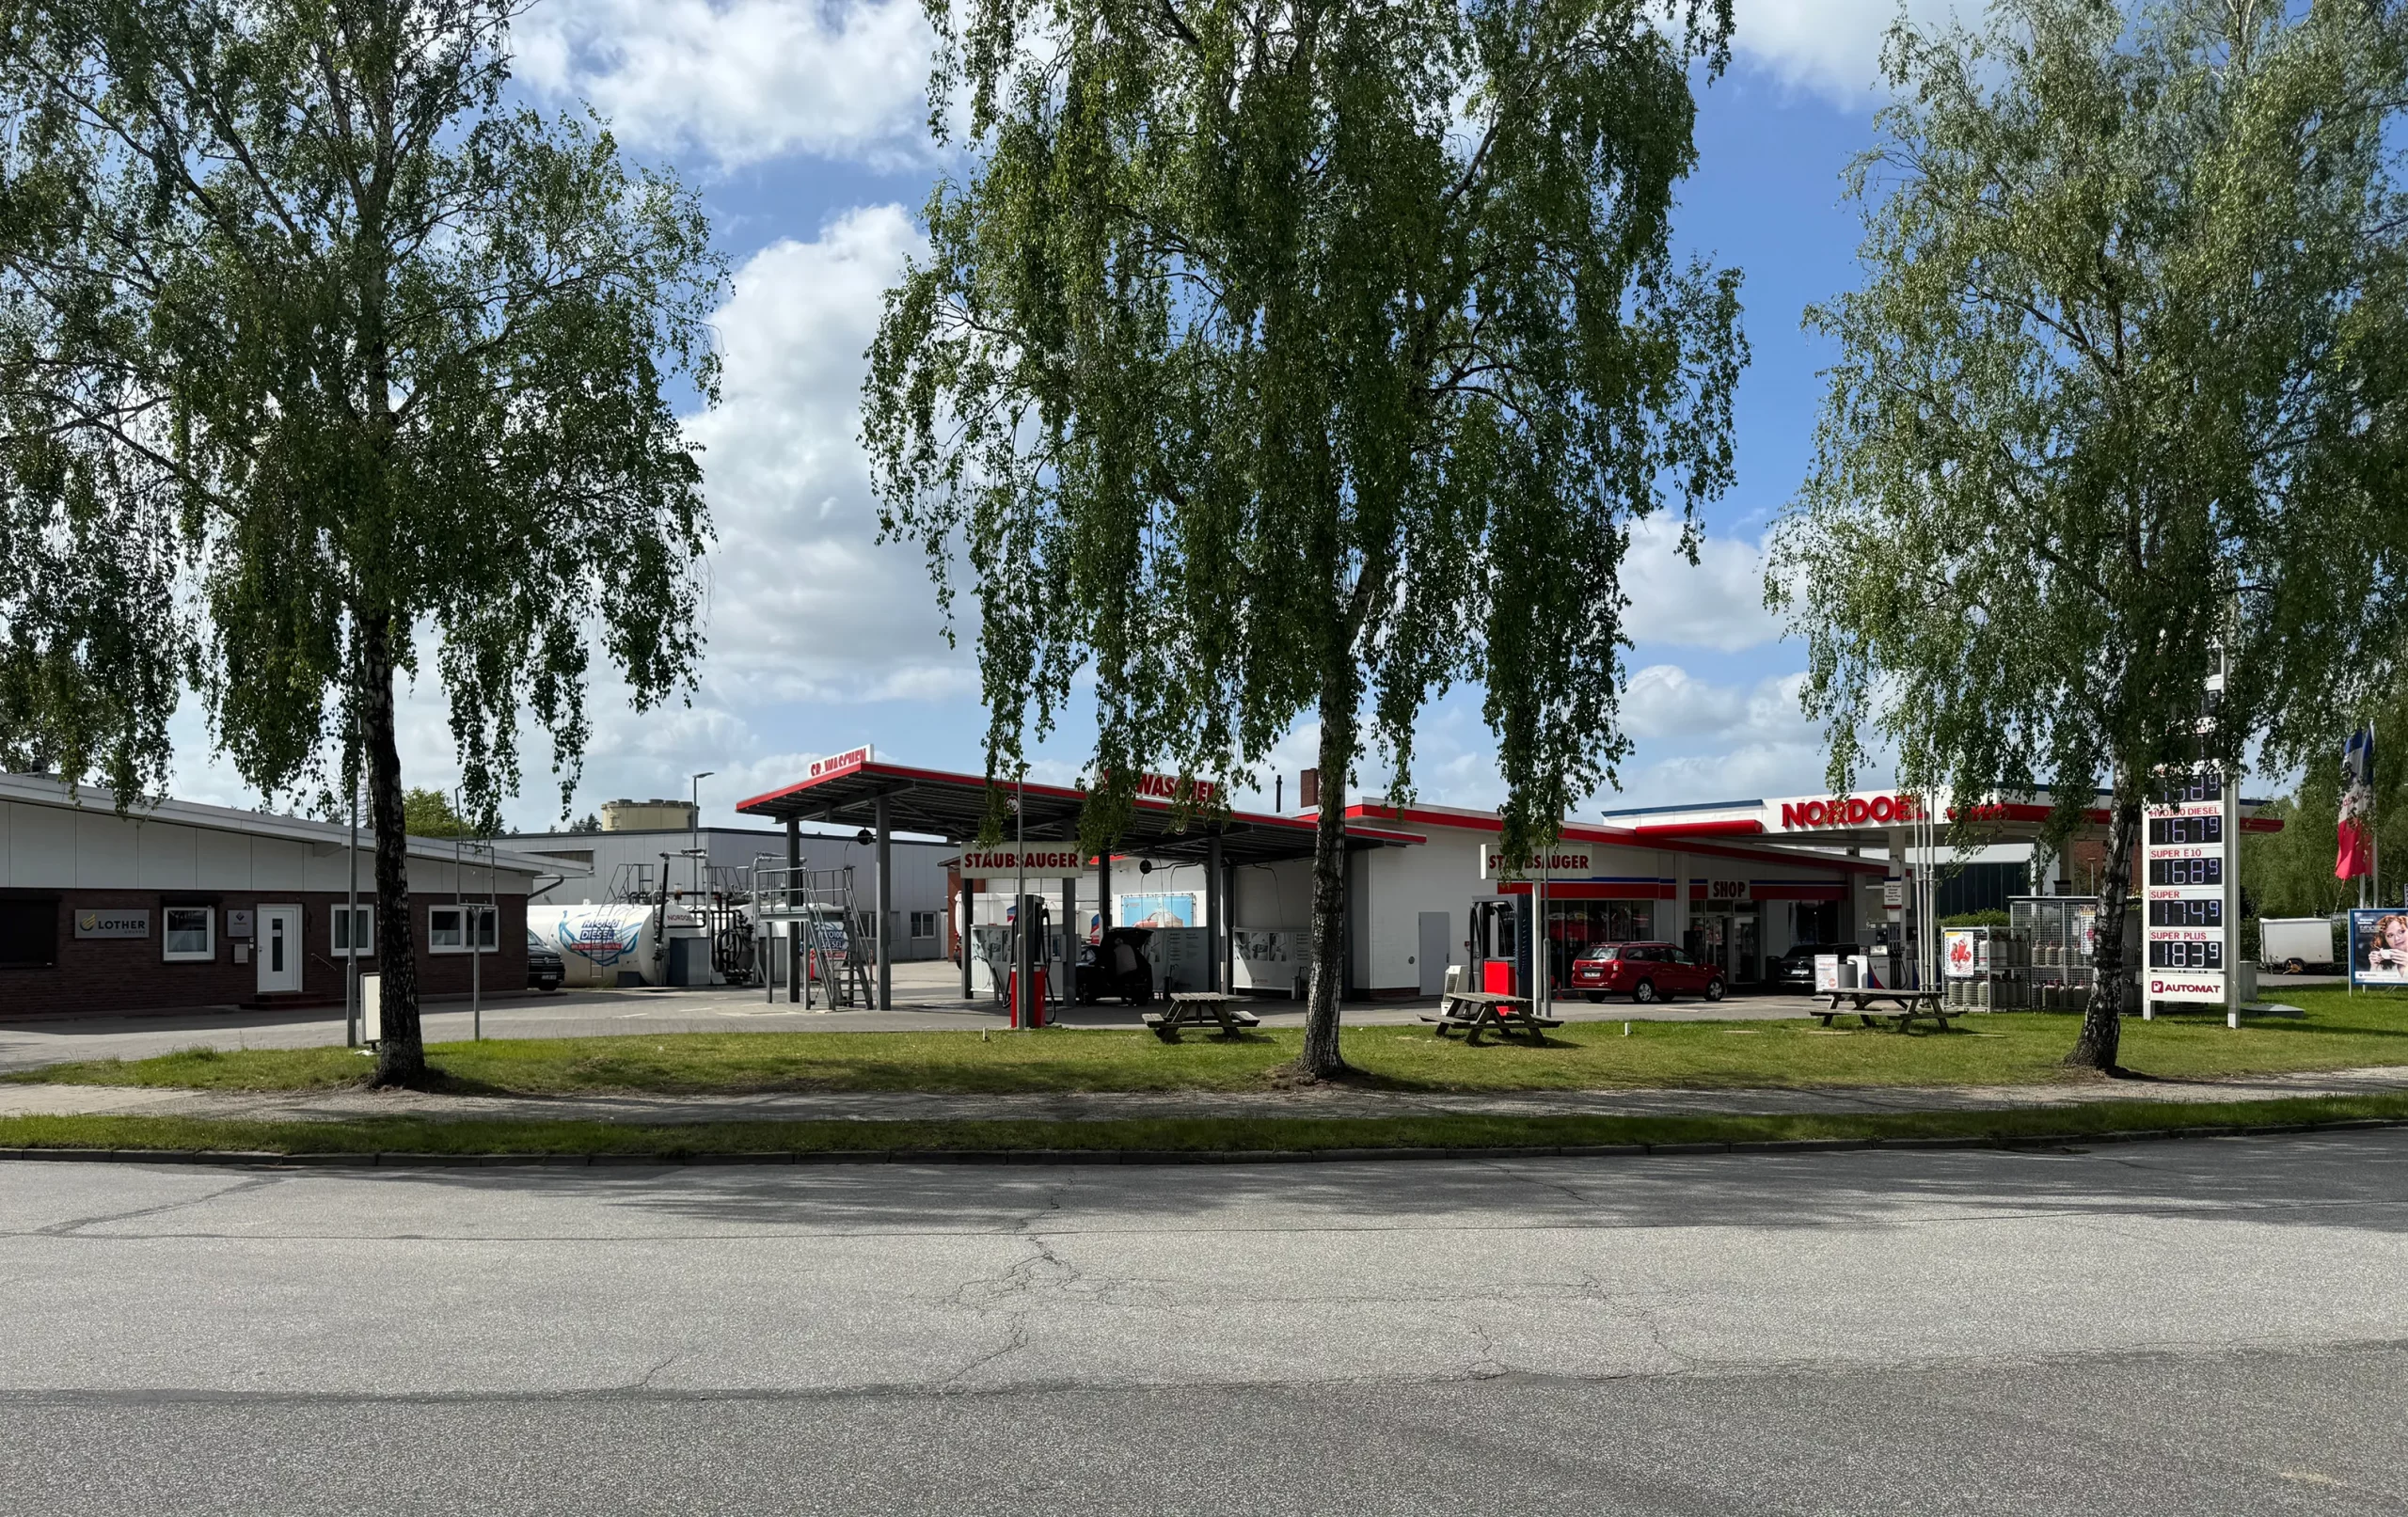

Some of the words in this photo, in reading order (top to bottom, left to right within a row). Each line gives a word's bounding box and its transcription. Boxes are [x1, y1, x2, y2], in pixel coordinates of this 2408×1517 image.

[2150, 808, 2186, 817] HVO10
[2187, 806, 2220, 816] DIESEL
[2150, 849, 2180, 858] SUPER
[1489, 855, 1589, 869] STBSAUGER
[1713, 880, 1746, 898] SHOP
[2150, 891, 2180, 899] SUPER
[98, 920, 146, 929] LOTHER
[581, 931, 613, 940] DIESEL
[2150, 931, 2180, 940] SUPER
[2183, 931, 2207, 940] PLUS
[2164, 984, 2221, 993] AUTOMAT
